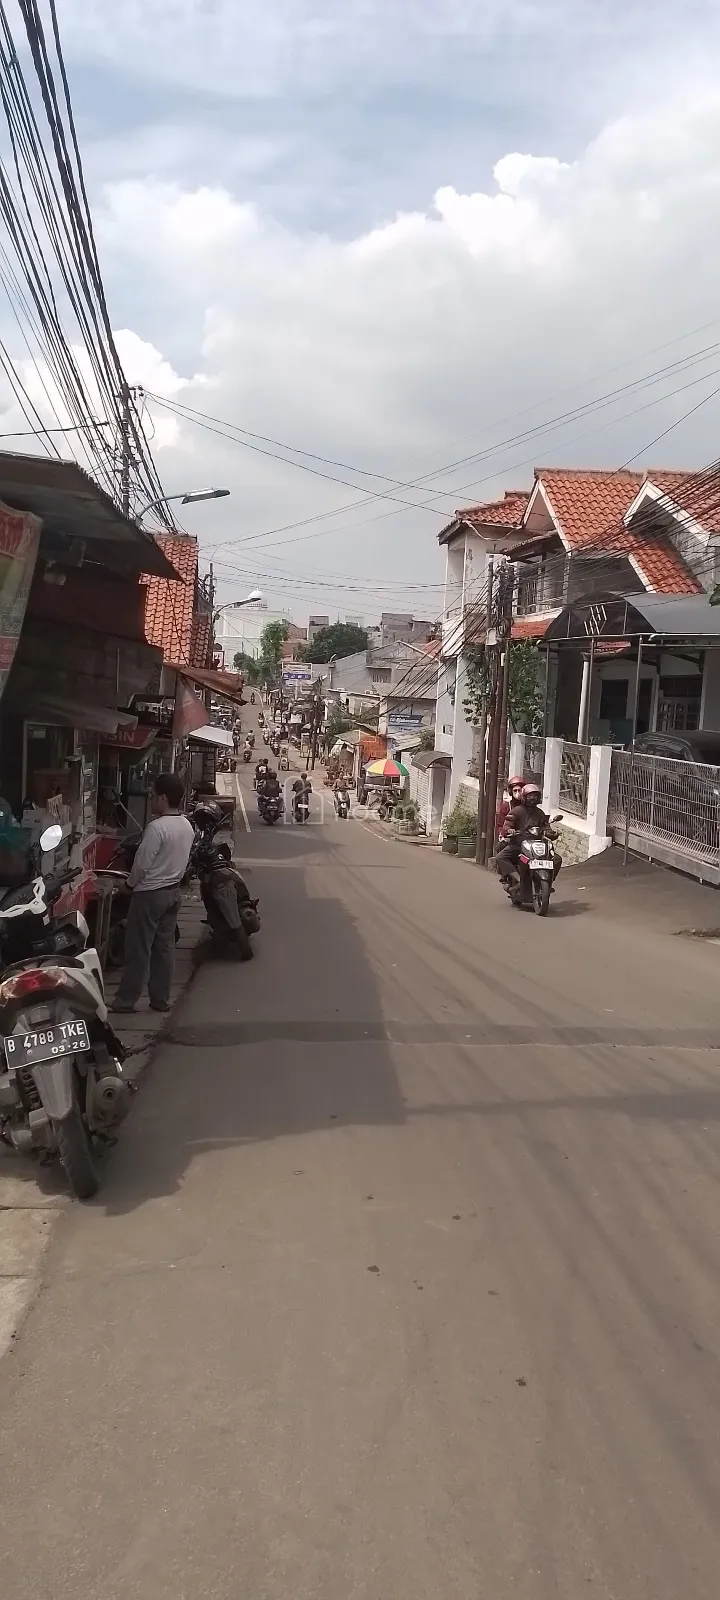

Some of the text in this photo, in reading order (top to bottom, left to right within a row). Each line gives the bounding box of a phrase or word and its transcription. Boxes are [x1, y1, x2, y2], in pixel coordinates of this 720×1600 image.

[7, 1022, 85, 1053] B 4788 TKE
